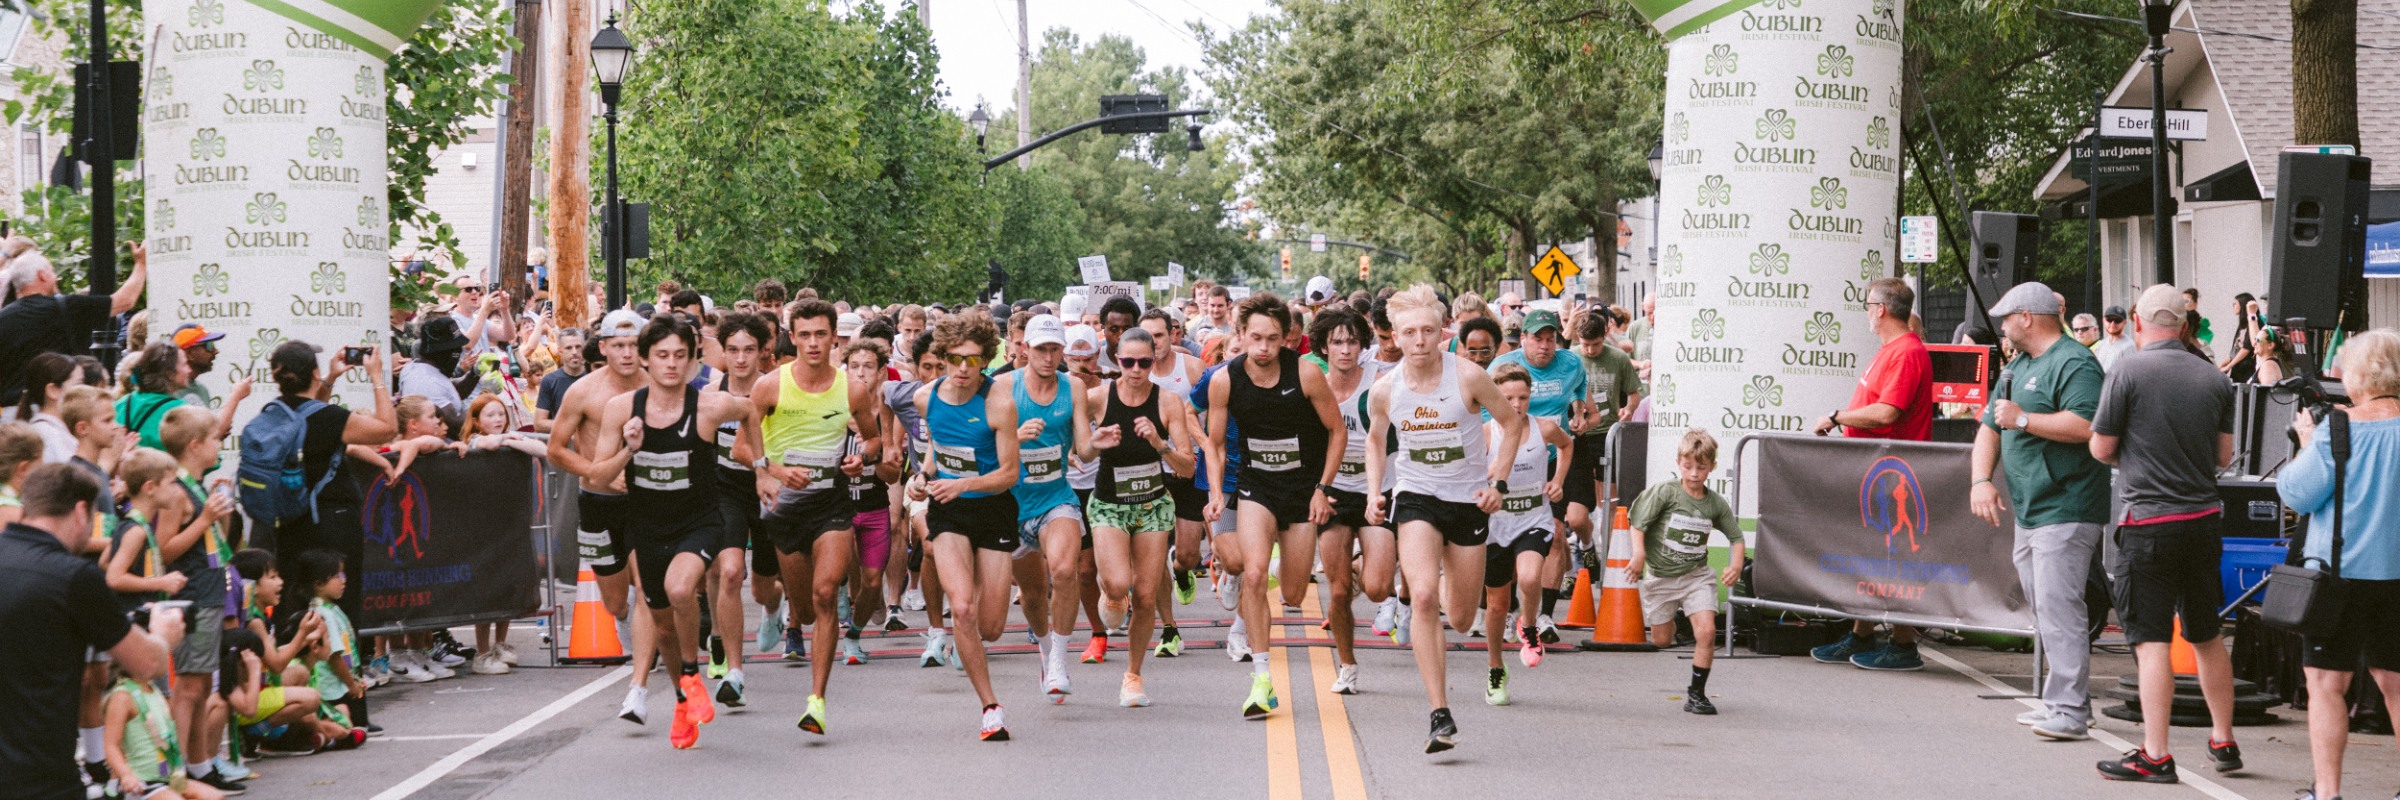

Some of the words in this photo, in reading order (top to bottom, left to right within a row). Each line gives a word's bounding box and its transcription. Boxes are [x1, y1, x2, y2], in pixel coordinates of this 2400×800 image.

[150, 102, 189, 123] UBLIN
[2118, 116, 2158, 129] Eberl
[2168, 118, 2190, 131] Hill
[2090, 164, 2140, 174] VESTMENTS
[151, 235, 192, 254] UBLIN
[1414, 406, 1439, 419] Ohio
[1401, 420, 1458, 432] Dominican
[1261, 453, 1287, 463] 1214
[1425, 450, 1447, 461] 437
[944, 457, 963, 468] 768
[1028, 463, 1048, 474] 693
[650, 469, 672, 480] 630
[1131, 480, 1150, 491] 678
[1507, 499, 1532, 509] 1216
[1682, 533, 1700, 544] 232
[1856, 580, 1925, 601] COMPANY
[363, 592, 432, 610] COMPANY
